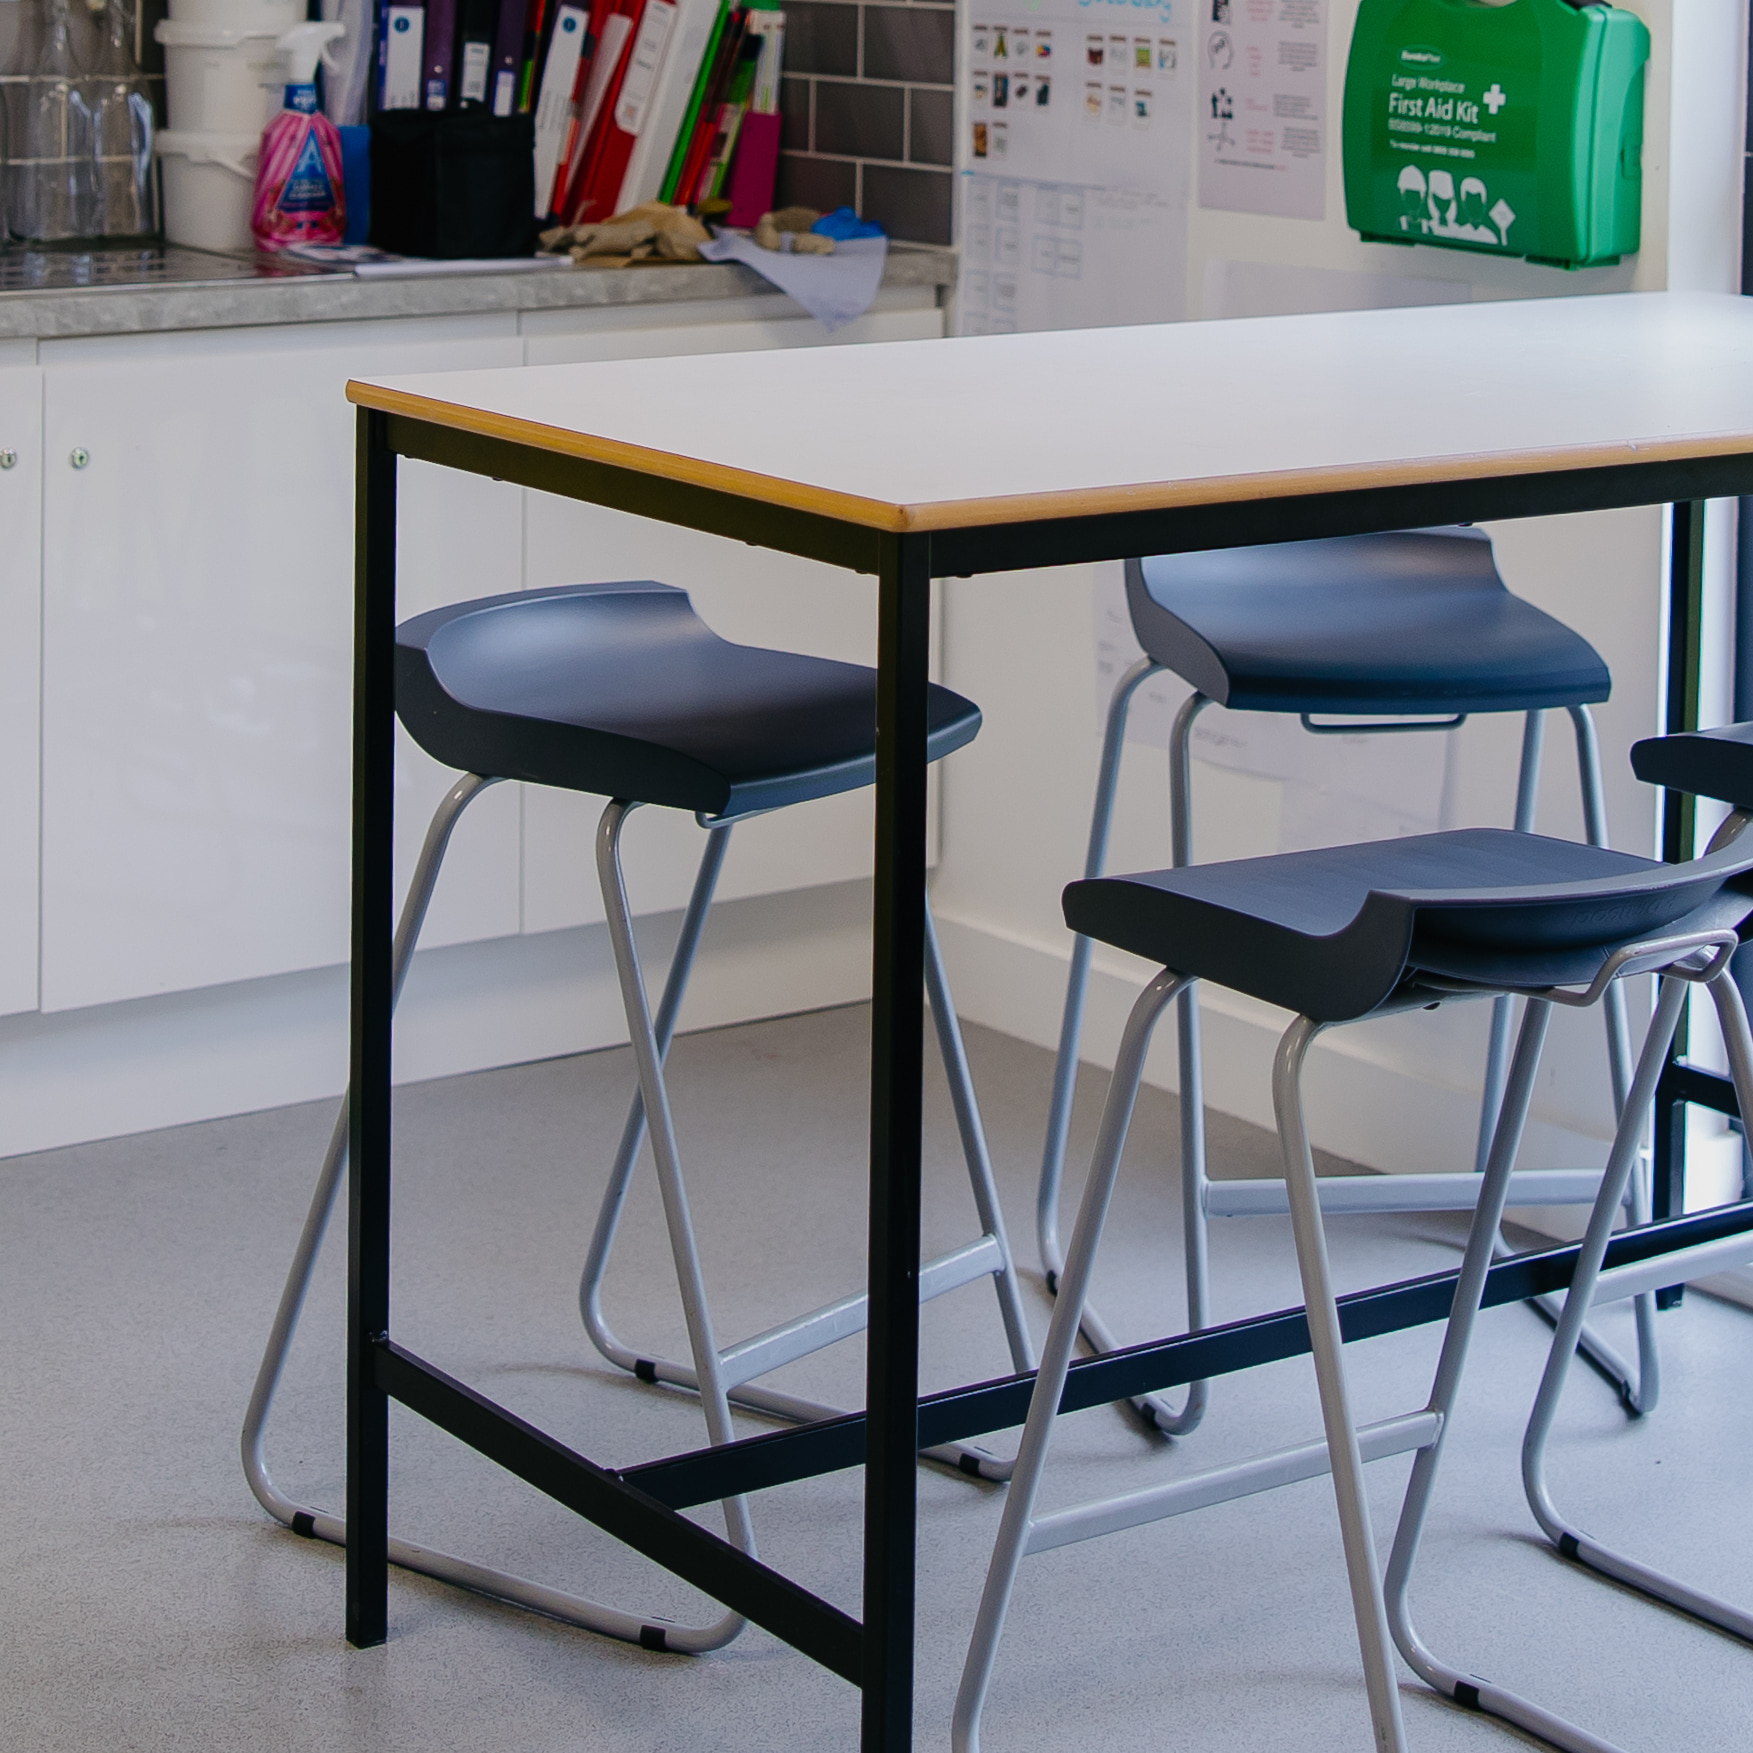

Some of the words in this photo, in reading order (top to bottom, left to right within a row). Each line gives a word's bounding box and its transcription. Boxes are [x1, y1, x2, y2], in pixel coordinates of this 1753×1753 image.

[1391, 73, 1417, 91] Large
[1417, 76, 1466, 94] Workplace
[1388, 91, 1424, 118] First
[1424, 96, 1454, 121] Aid
[1456, 99, 1480, 124] Kit
